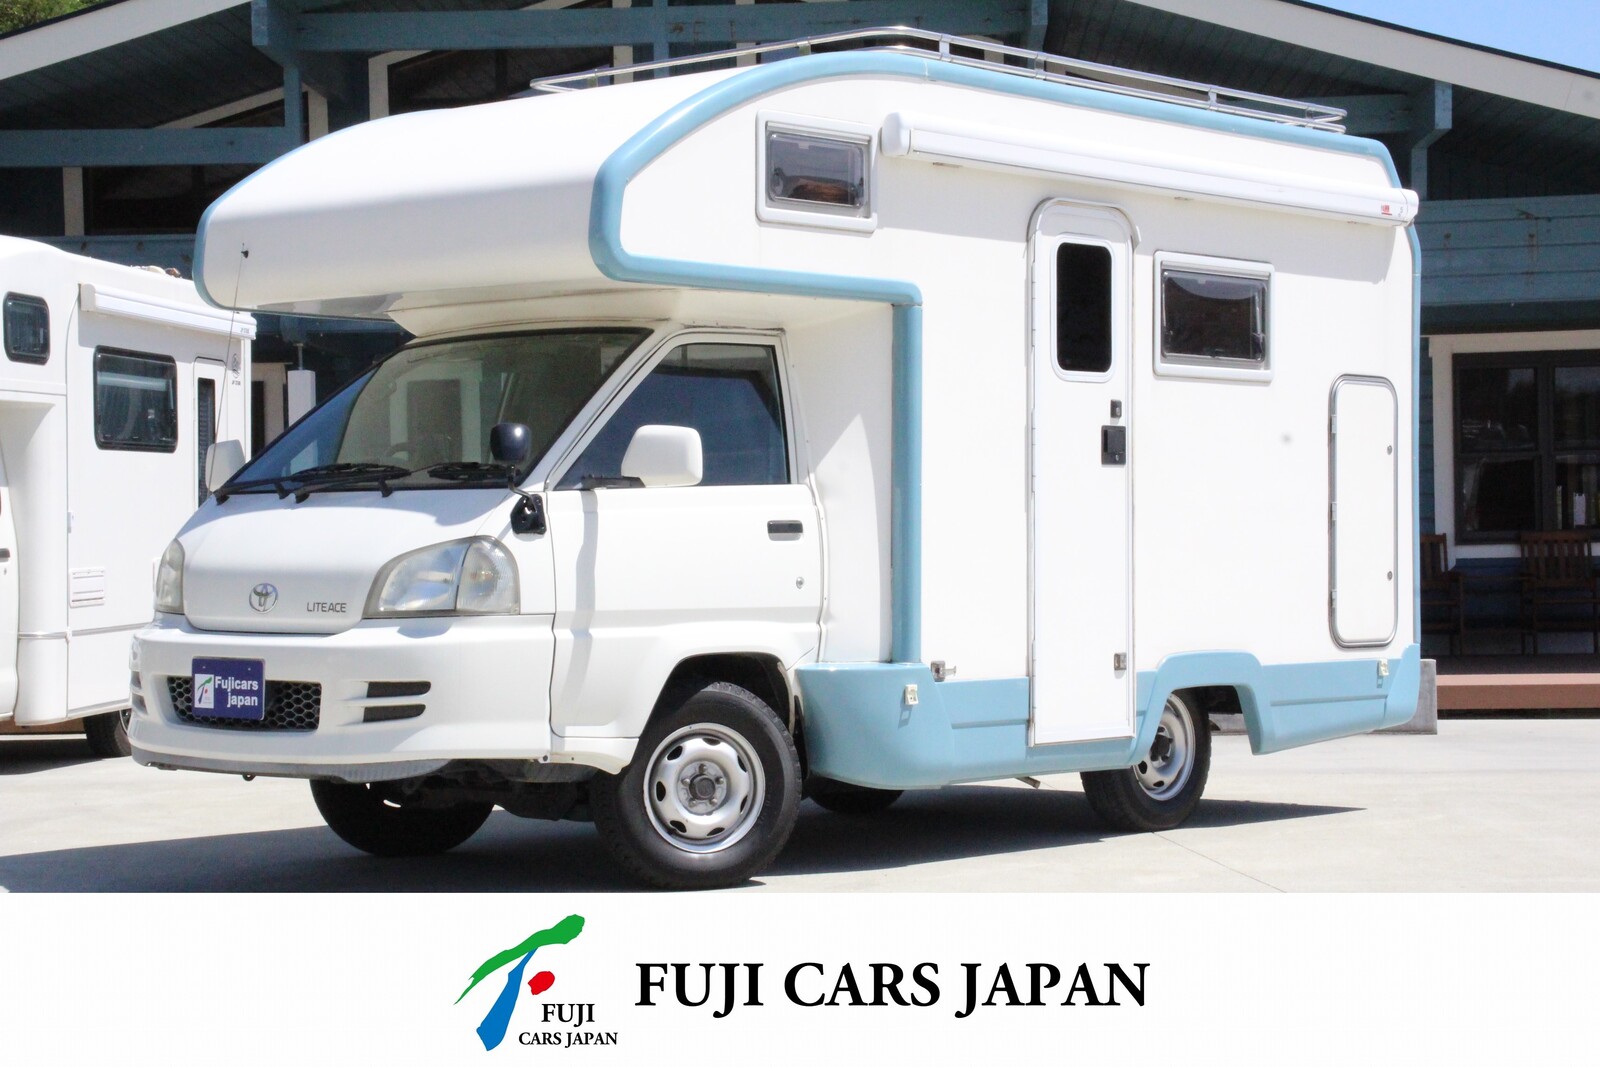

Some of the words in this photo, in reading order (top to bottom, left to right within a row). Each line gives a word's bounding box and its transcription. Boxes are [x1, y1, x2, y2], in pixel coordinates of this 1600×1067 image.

[306, 602, 347, 613] LITEACE
[215, 676, 259, 692] Fujicars
[227, 692, 258, 708] japan
